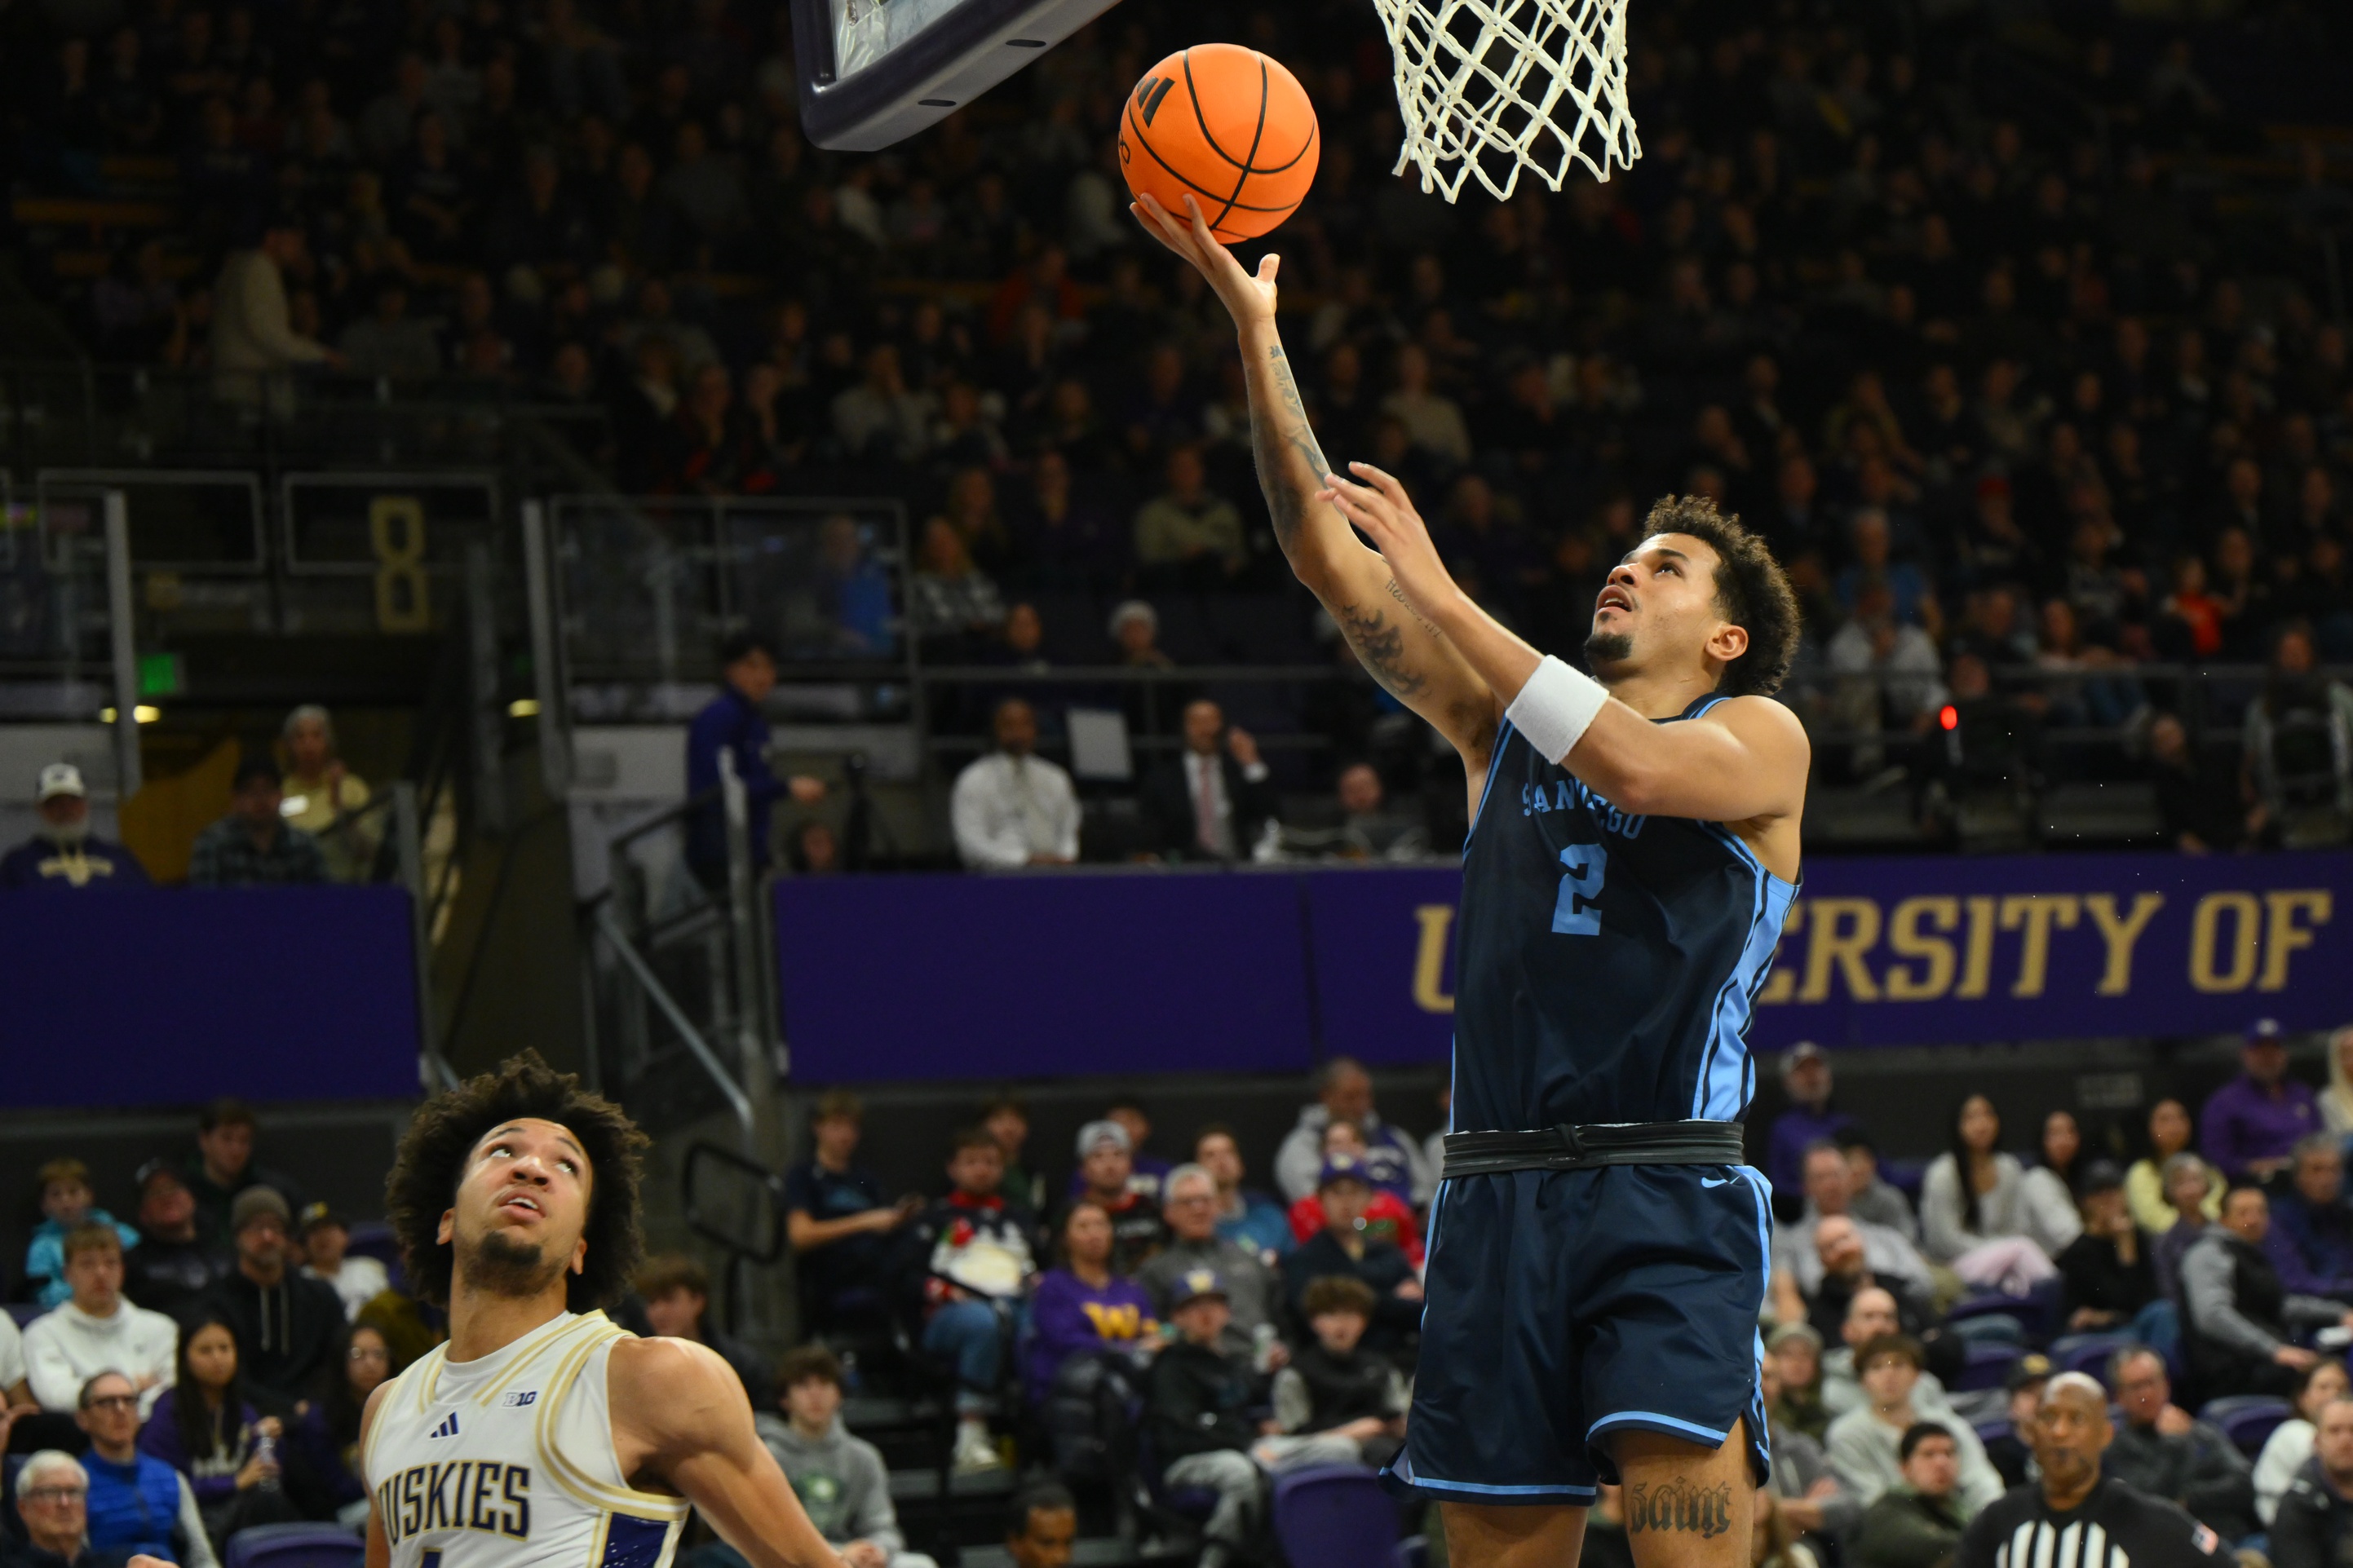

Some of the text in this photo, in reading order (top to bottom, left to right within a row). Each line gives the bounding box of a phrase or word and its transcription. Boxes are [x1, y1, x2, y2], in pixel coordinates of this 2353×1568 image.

[1522, 779, 1576, 816] SAN
[1551, 843, 1608, 936] 2
[2188, 888, 2335, 993] OF
